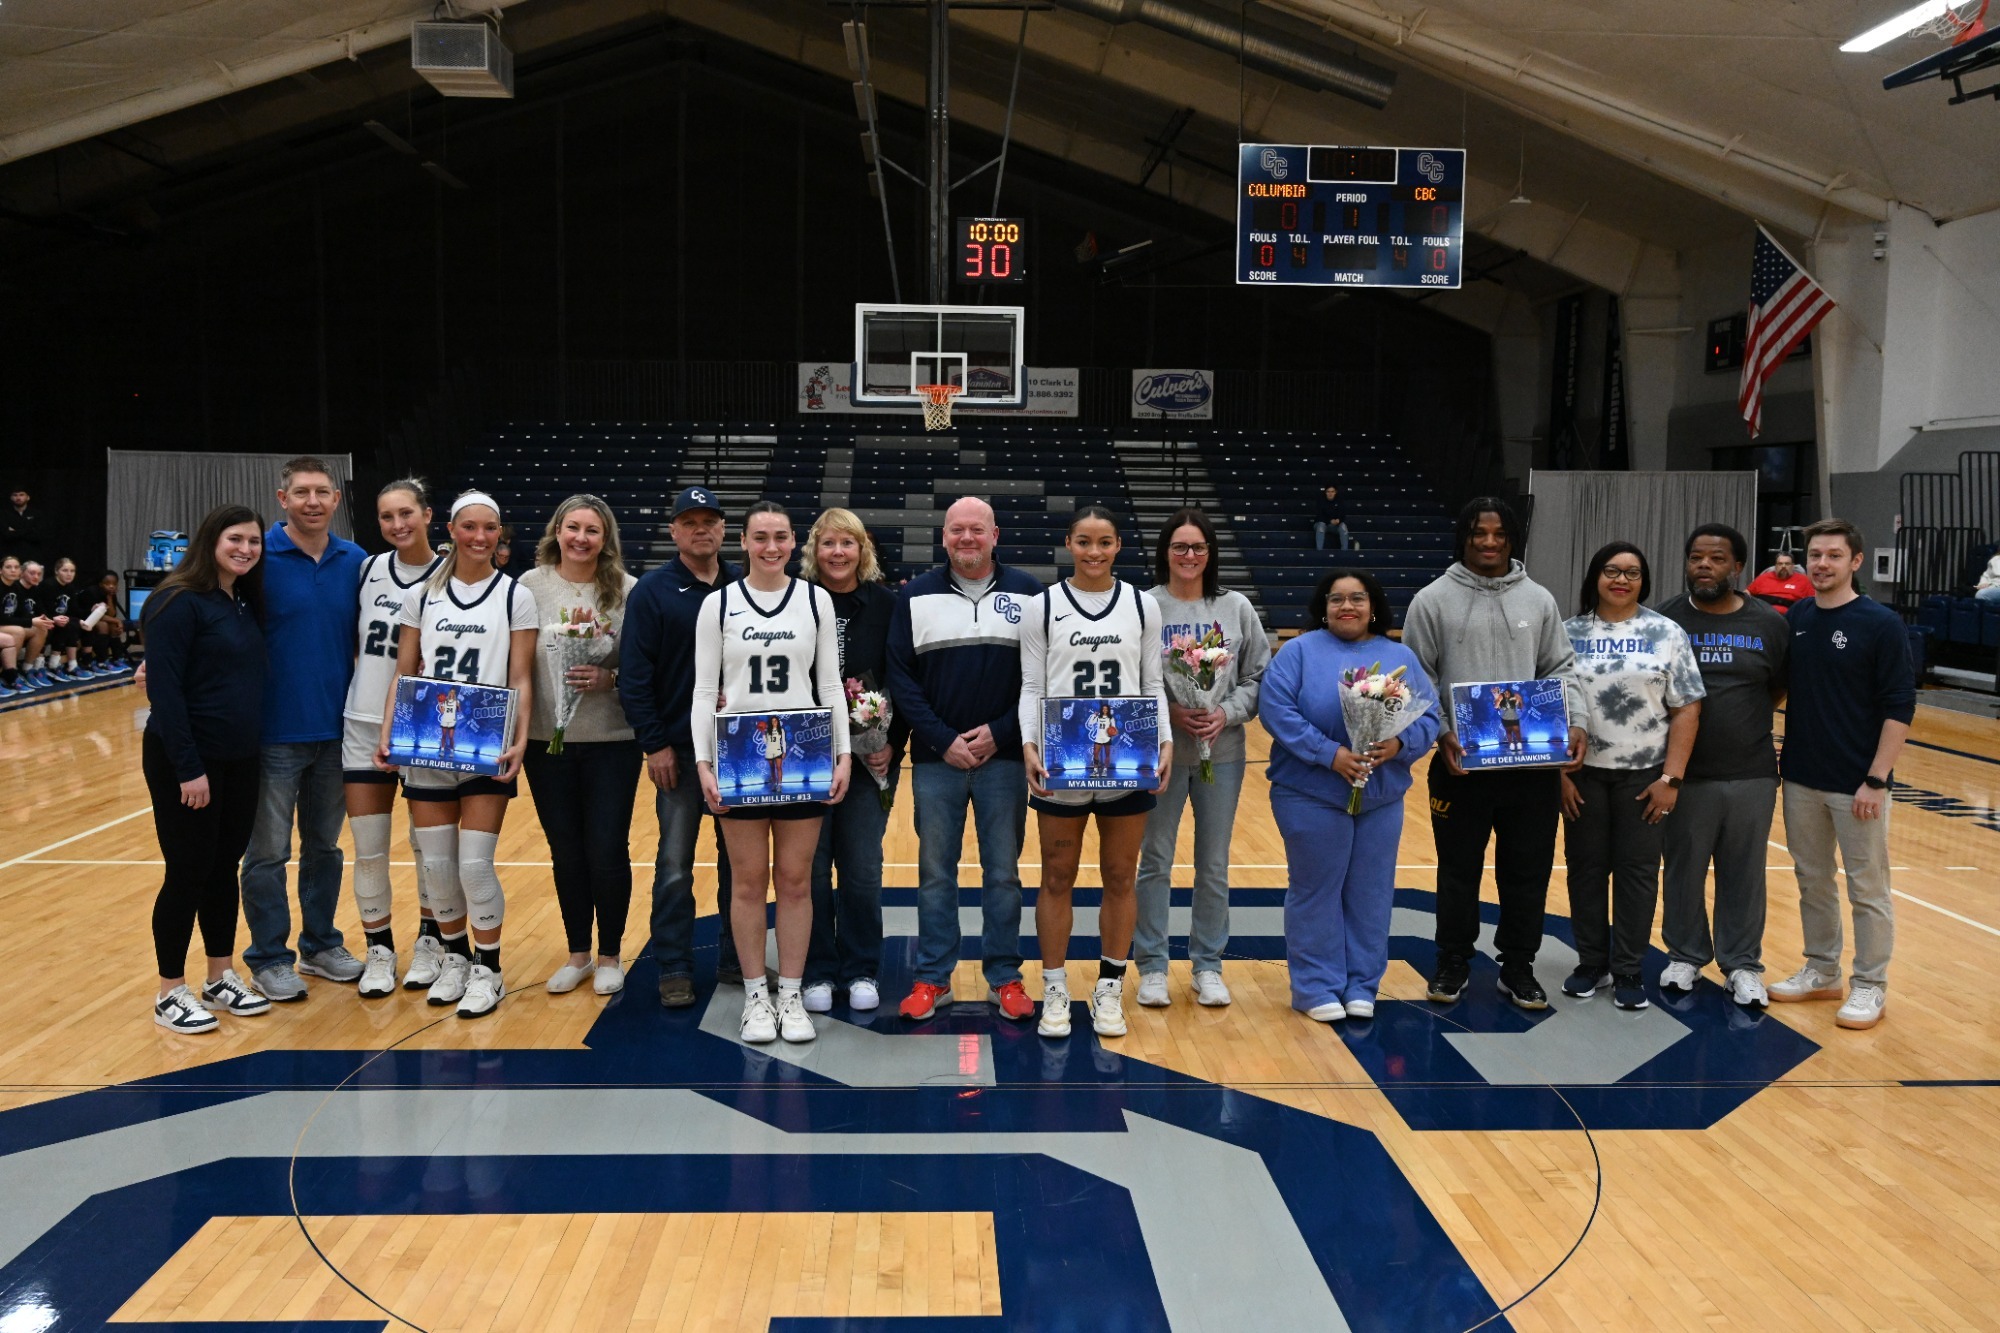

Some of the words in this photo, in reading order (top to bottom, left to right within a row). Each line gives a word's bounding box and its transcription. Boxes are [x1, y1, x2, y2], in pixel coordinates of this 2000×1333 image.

[1248, 184, 1306, 198] COLUMBIA
[1336, 193, 1367, 203] PERIOD
[1415, 188, 1436, 200] CBC
[970, 224, 1018, 242] 10:00
[1250, 233, 1277, 243] FOULS
[1289, 234, 1310, 244] T.O.L.
[1323, 235, 1355, 244] PLAYER
[1358, 236, 1380, 245] FOUL
[1390, 236, 1412, 246] T.O.L.
[1423, 237, 1450, 246] FOULS
[966, 244, 1010, 276] 30
[1261, 245, 1274, 266] 0
[1434, 249, 1446, 270] 0
[1249, 272, 1277, 281] SCORE
[1335, 273, 1364, 282] MATCH
[1421, 274, 1449, 284] SCORE
[1135, 371, 1205, 405] Culver's
[691, 490, 706, 504] CC
[374, 594, 402, 616] Coug
[994, 594, 1021, 624] CC
[436, 618, 487, 640] Cougars
[742, 626, 796, 647] Cougars
[1070, 631, 1122, 652] Cougars
[1688, 633, 1764, 650] LUMBIA
[1832, 630, 1848, 649] CC
[1570, 638, 1654, 654] OLUMBIA
[434, 646, 481, 682] 24
[1700, 652, 1732, 662] DAD
[748, 655, 790, 694] 13
[1073, 660, 1120, 696] 23
[410, 758, 428, 766] LEXI
[429, 760, 454, 769] RUBEL
[460, 764, 476, 772] #24
[1498, 756, 1513, 764] DEE
[1515, 754, 1551, 762] HAWKINS
[1068, 780, 1086, 788] MYA
[1087, 780, 1117, 788] MILLER
[1123, 780, 1138, 788] #23
[742, 796, 760, 804] LEXI
[761, 794, 790, 802] MILLER
